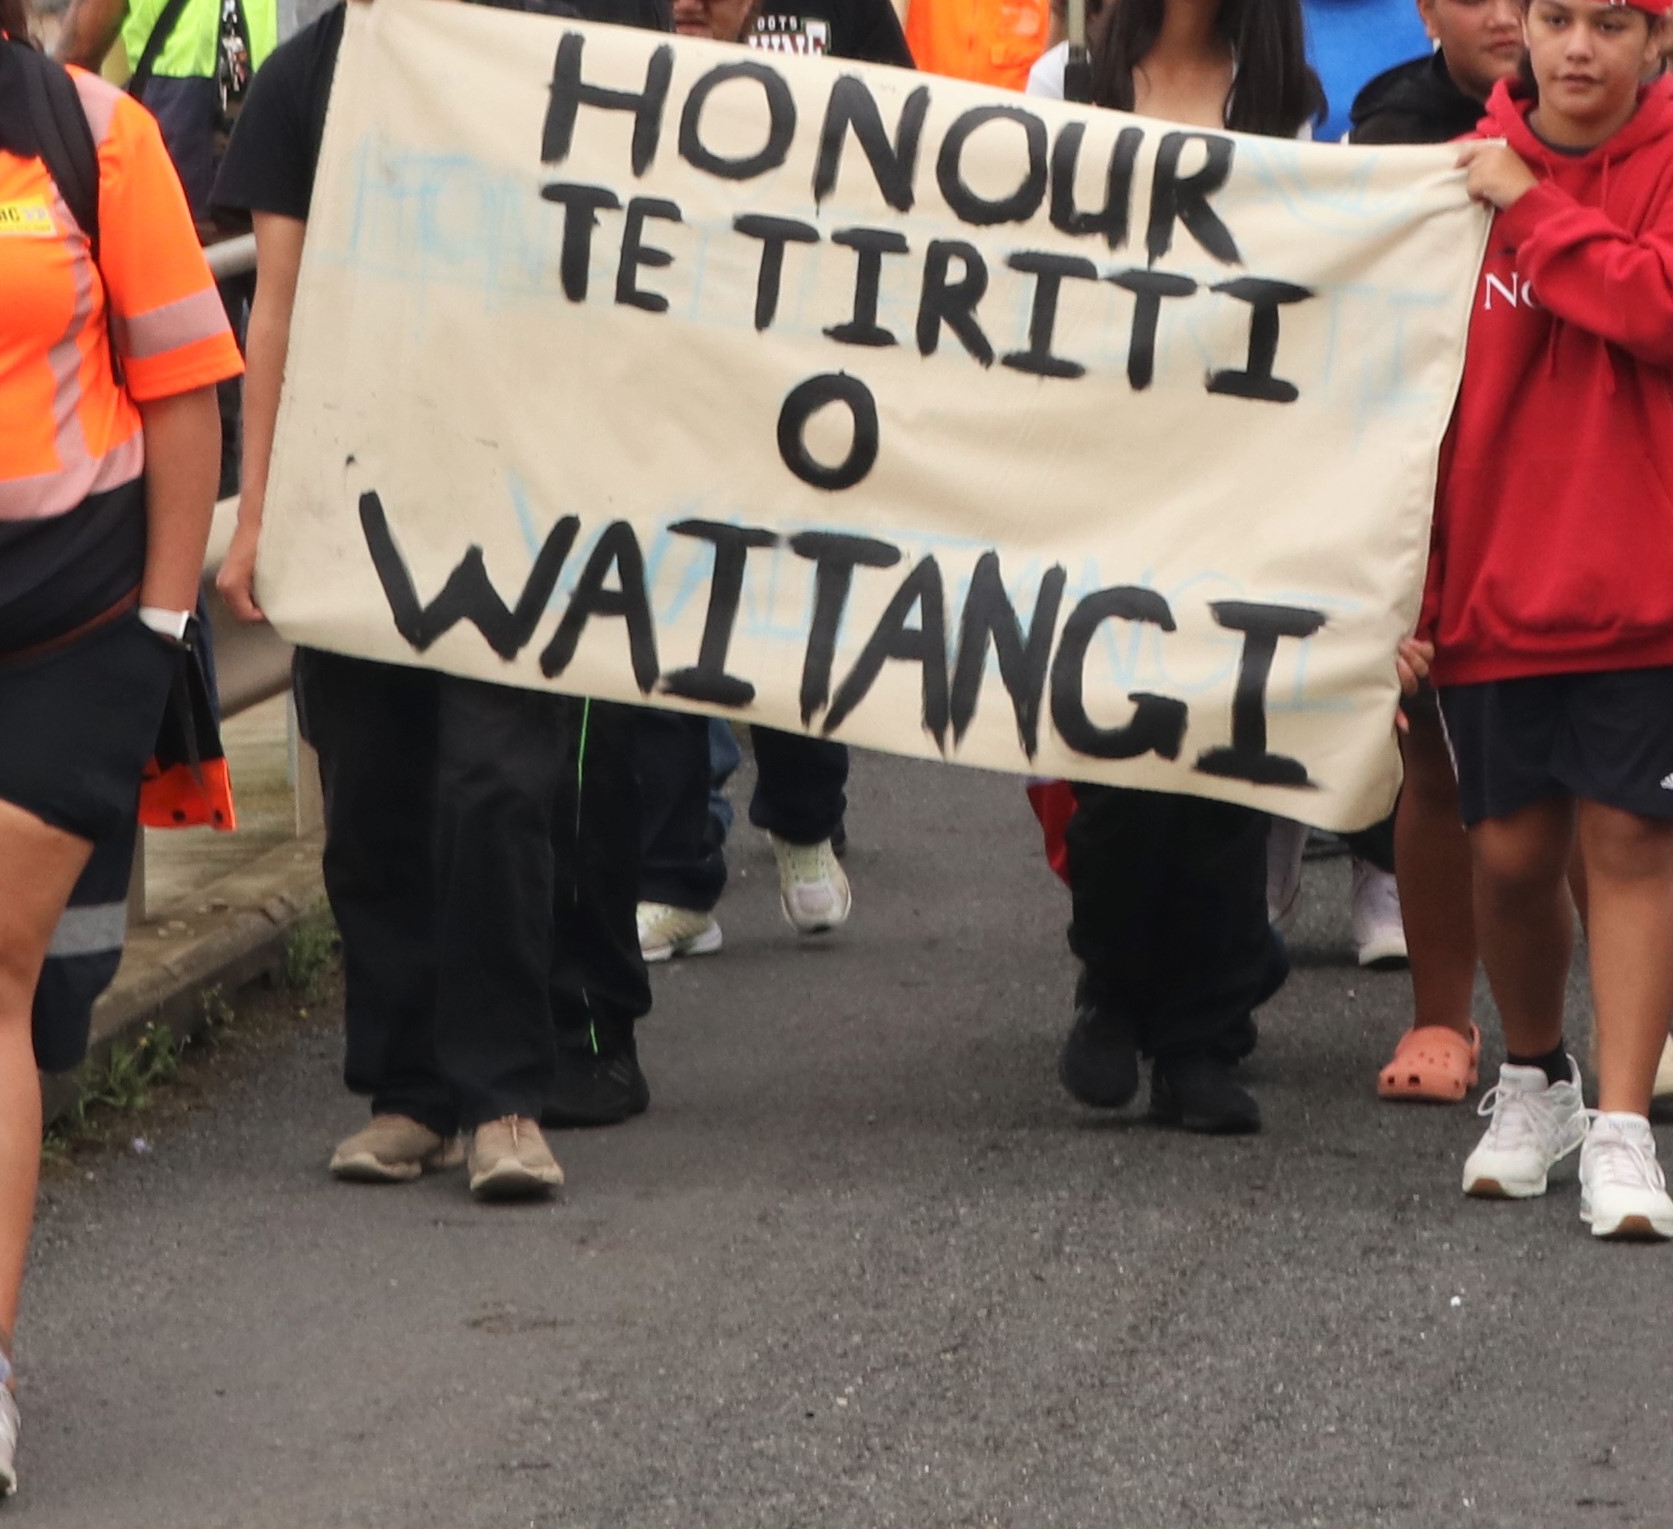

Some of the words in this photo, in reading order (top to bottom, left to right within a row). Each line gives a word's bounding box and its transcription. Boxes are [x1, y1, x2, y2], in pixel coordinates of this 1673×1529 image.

[756, 15, 798, 32] OOTS
[541, 32, 1240, 266] HONOUR
[540, 183, 682, 313] TE
[733, 215, 1315, 404] TIRITI
[777, 371, 879, 492] O
[359, 490, 1326, 790] WAITANGI
